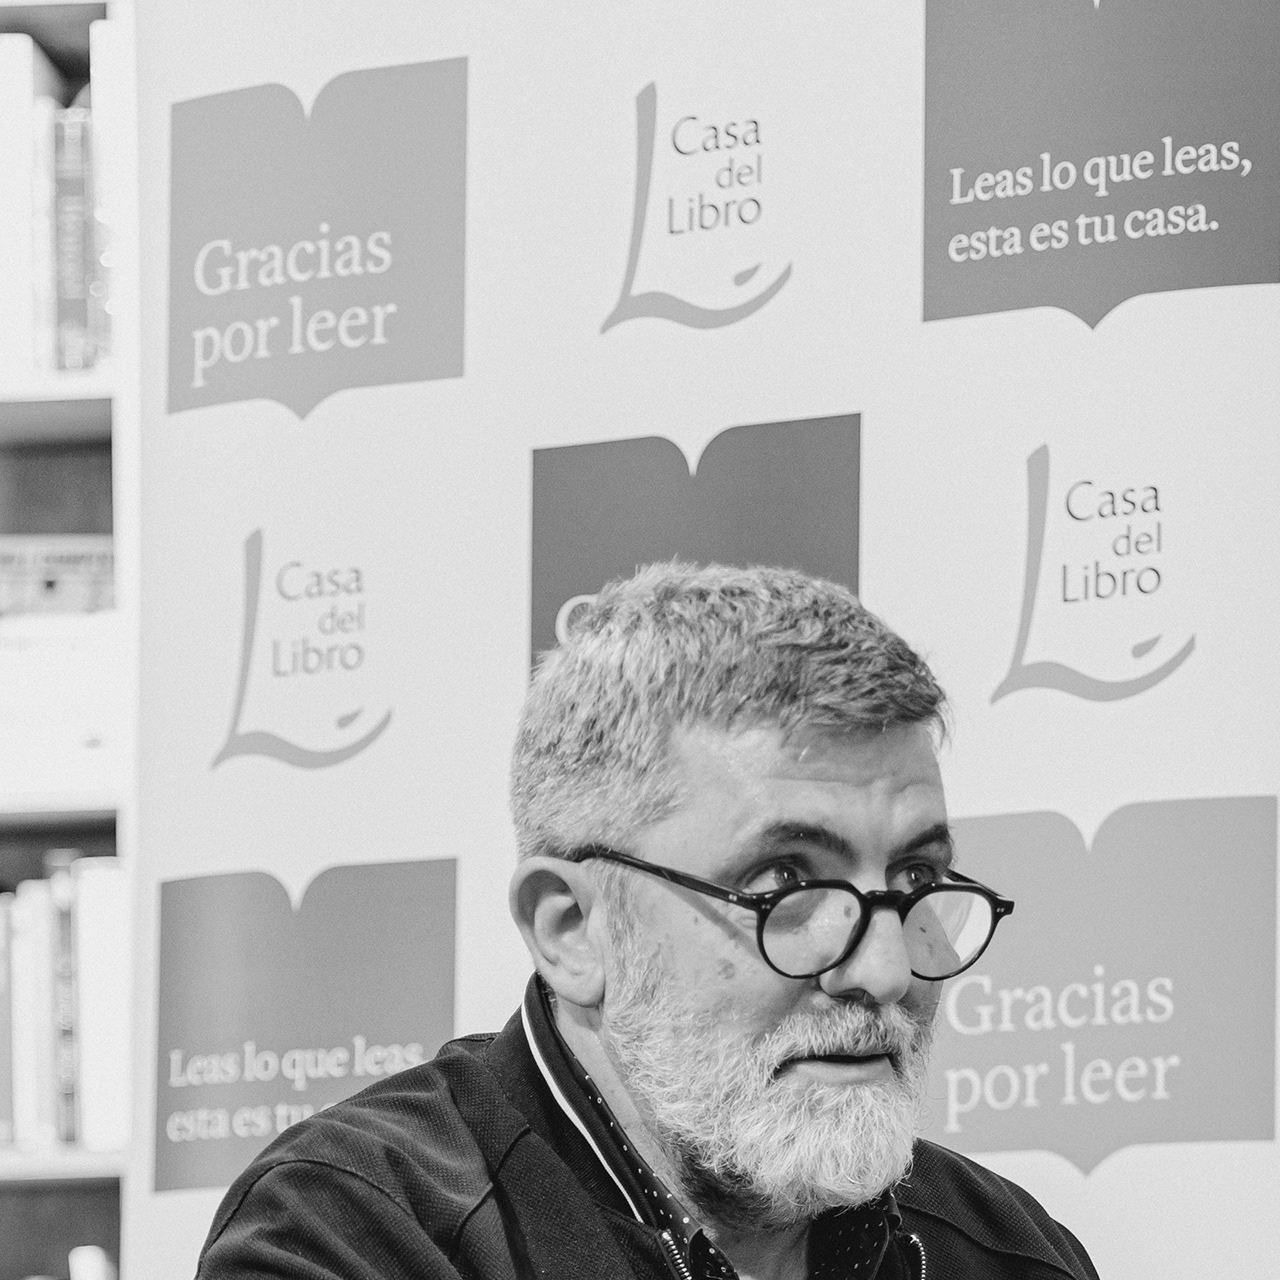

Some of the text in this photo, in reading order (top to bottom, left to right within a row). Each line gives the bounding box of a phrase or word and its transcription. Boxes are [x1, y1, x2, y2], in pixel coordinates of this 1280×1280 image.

[672, 116, 761, 155] Casa
[715, 153, 762, 189] del
[949, 136, 1253, 205] Leas lo que leas,
[668, 192, 762, 234] Libro
[948, 203, 1220, 262] esta es tu casa.
[193, 222, 393, 296] Gracias
[191, 295, 398, 388] por leer
[1065, 480, 1161, 521] Casa
[1112, 521, 1162, 557] del
[275, 561, 363, 601] Casa
[1062, 560, 1162, 602] Libro
[318, 602, 365, 635] del
[272, 636, 365, 678] Libro
[945, 964, 1175, 1035] Gracias
[168, 1049, 241, 1087] Leas
[243, 1040, 279, 1082] lo
[281, 1046, 350, 1091] que
[943, 1041, 1181, 1134] por leer
[166, 1106, 231, 1143] esta
[232, 1105, 272, 1138] es
